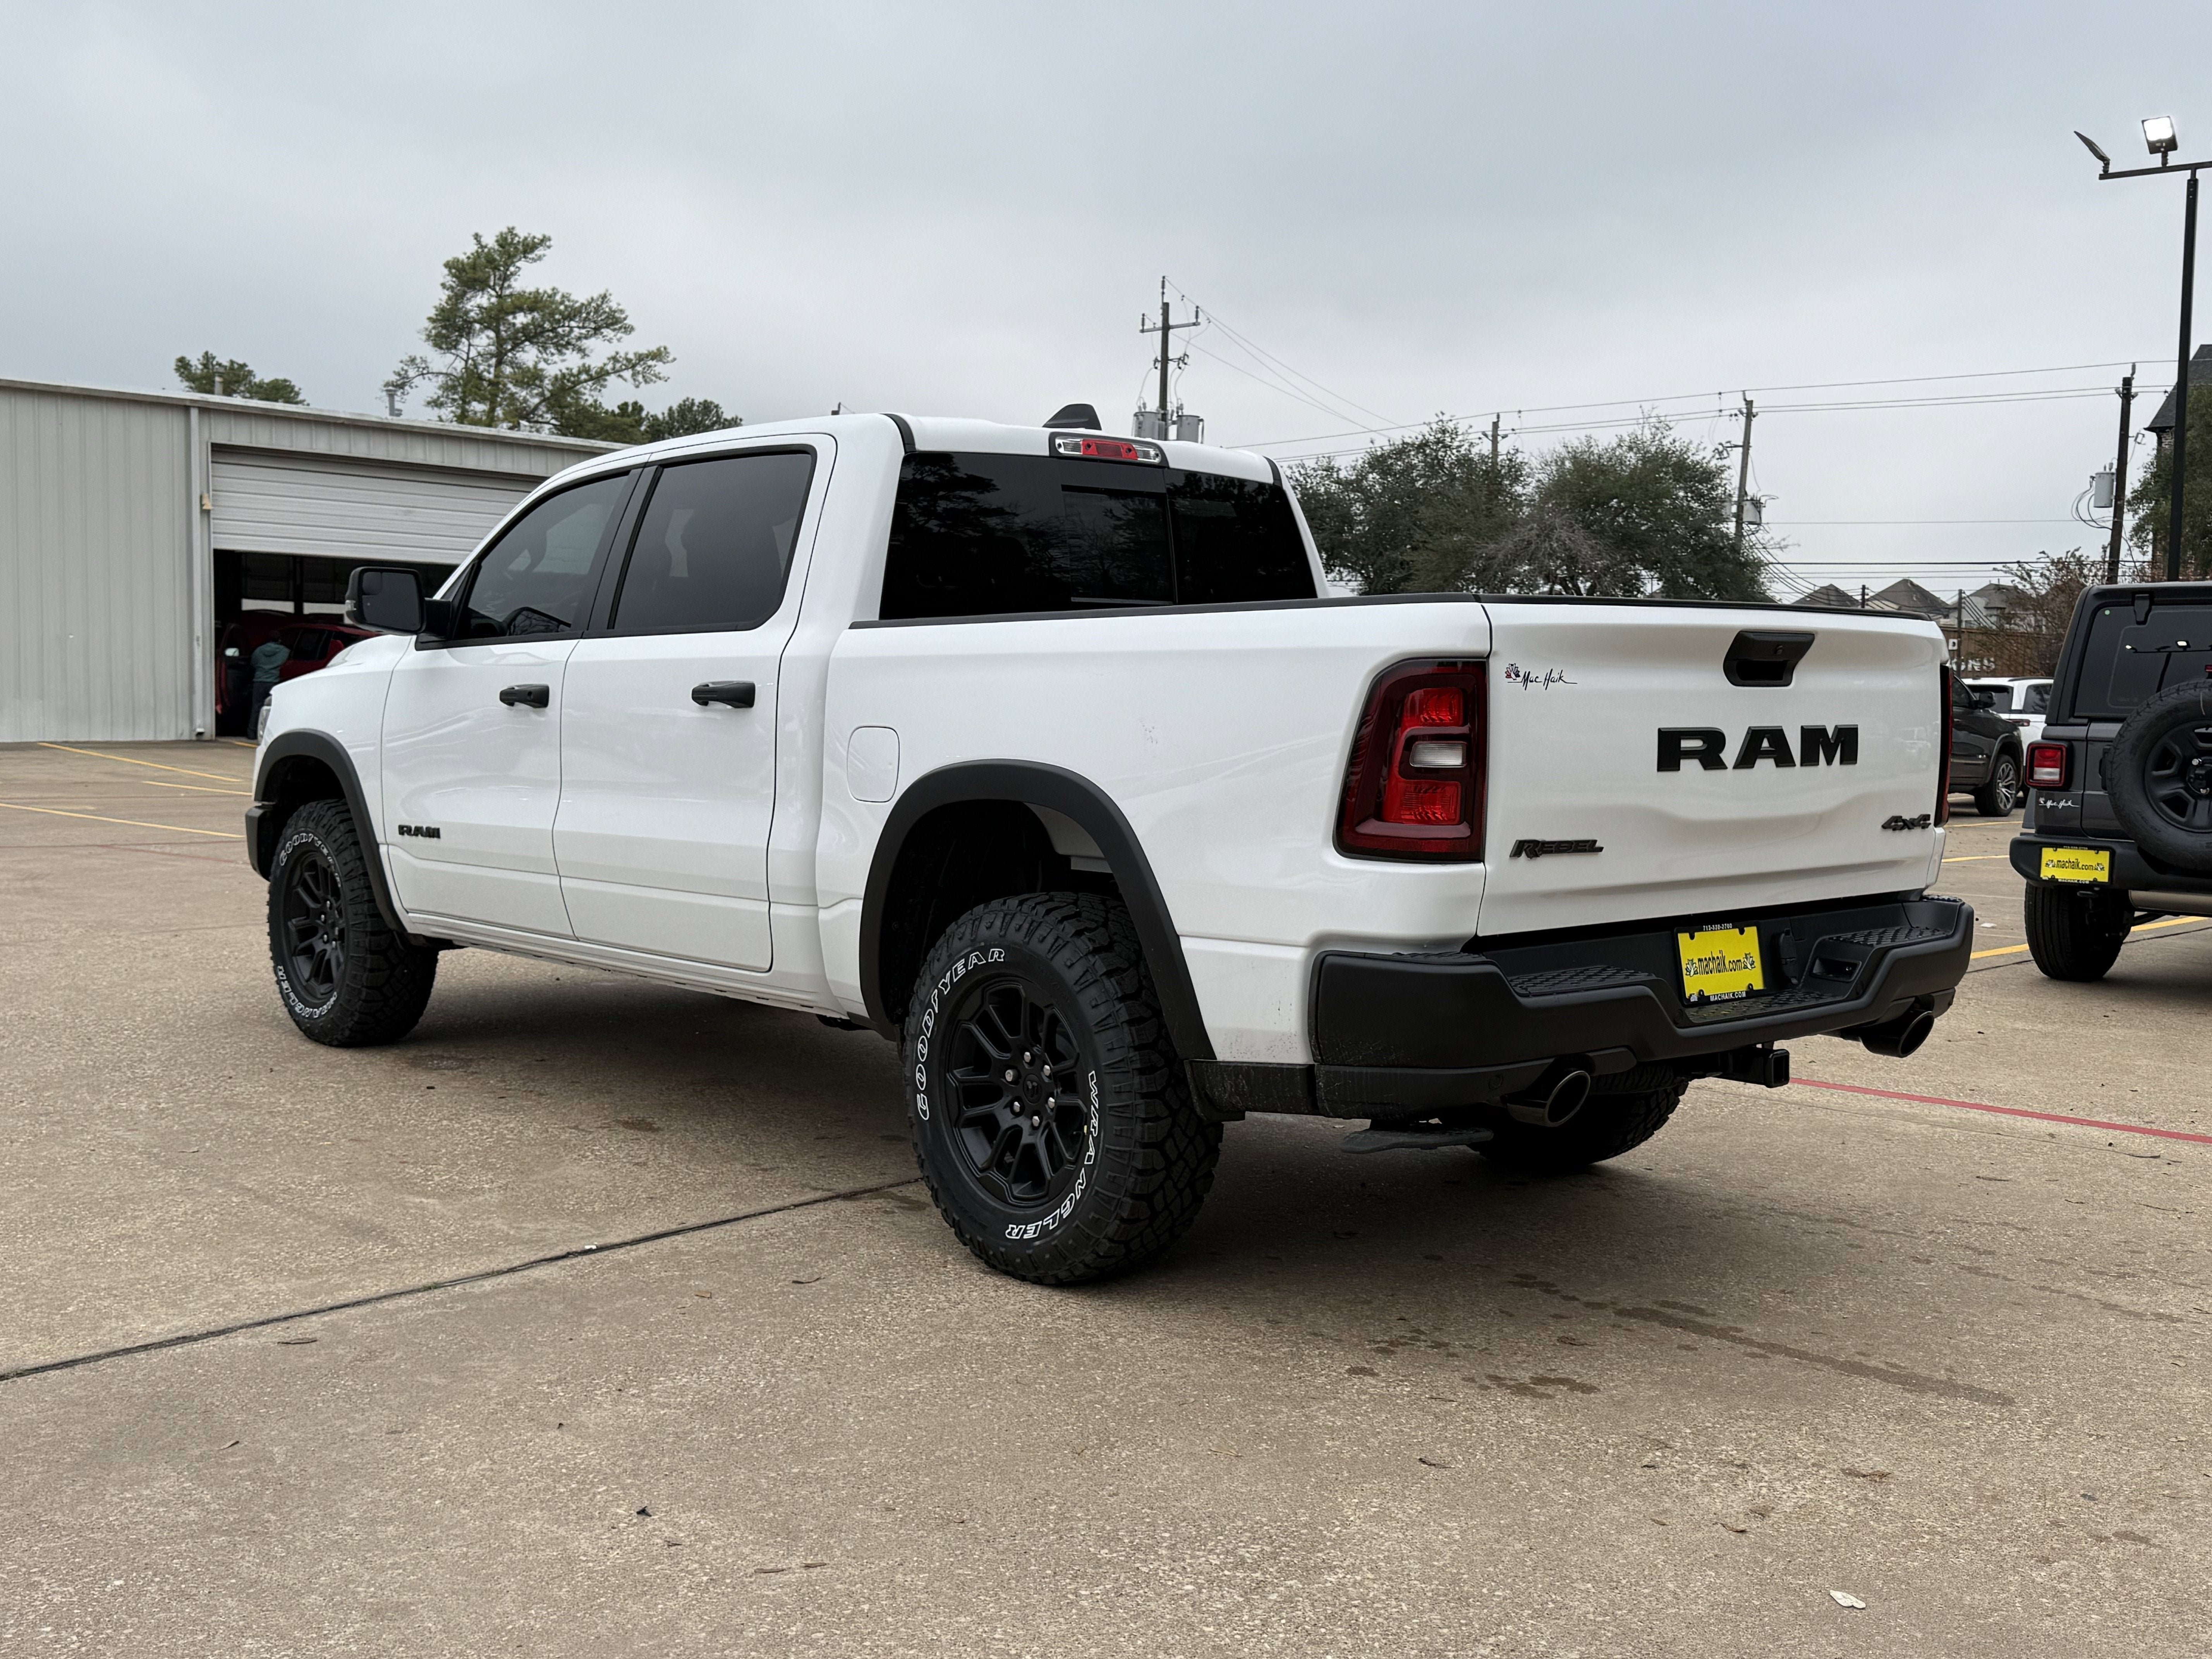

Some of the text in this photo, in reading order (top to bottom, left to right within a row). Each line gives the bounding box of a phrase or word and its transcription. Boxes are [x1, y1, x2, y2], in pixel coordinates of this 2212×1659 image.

[1511, 668, 1577, 690] Mac Haik
[1657, 724, 1858, 772] RAM
[398, 824, 441, 839] RAM
[1509, 839, 1604, 859] REBEL
[2056, 858, 2094, 871] machaik.com
[1698, 950, 1743, 975] machaik.com
[1710, 991, 1746, 1002] MACHAIK.COM
[915, 948, 1005, 1120] GOODYEAR
[1005, 1070, 1099, 1239] WRANGLER
